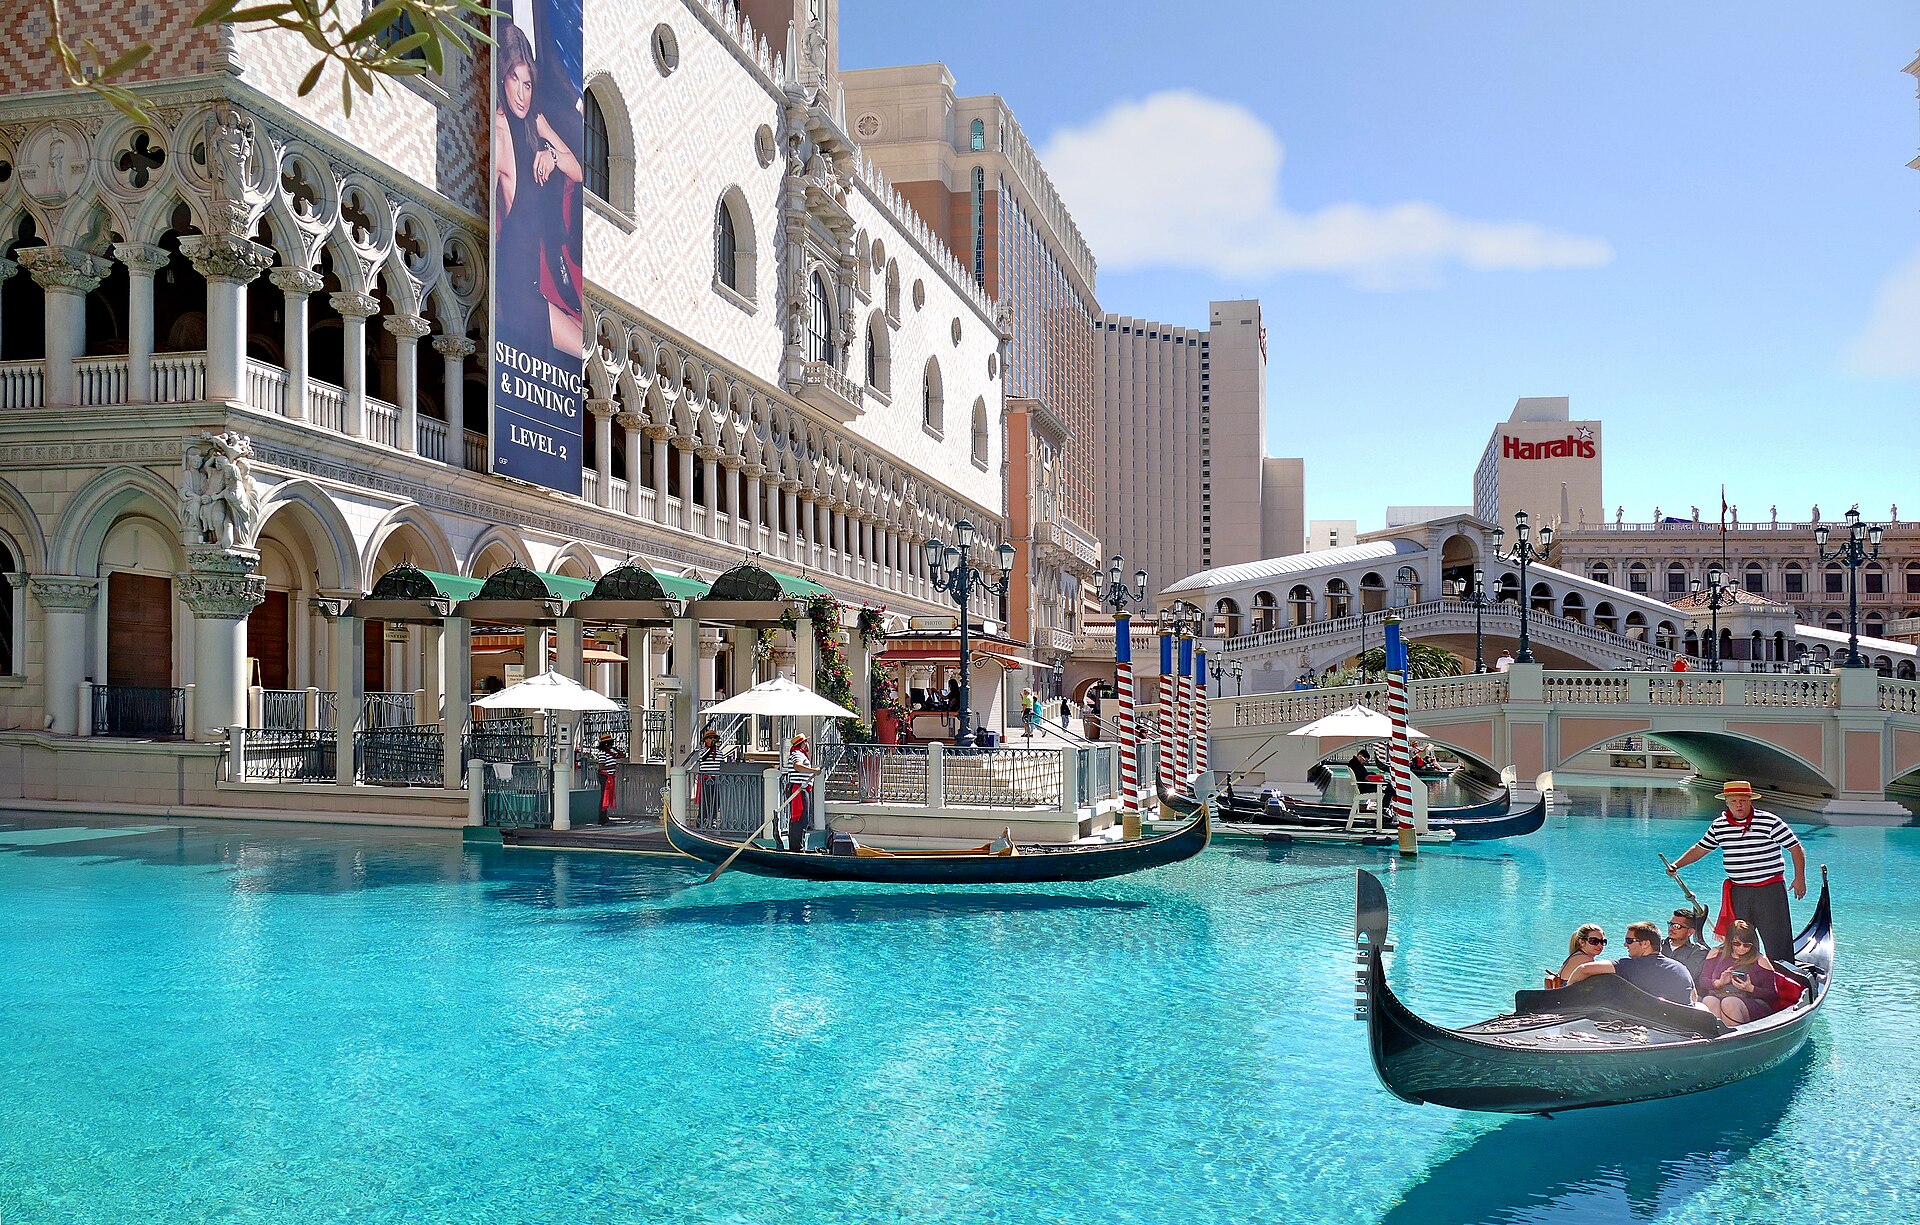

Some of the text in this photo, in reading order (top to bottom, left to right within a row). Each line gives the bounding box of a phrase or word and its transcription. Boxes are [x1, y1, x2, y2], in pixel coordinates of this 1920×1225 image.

[495, 340, 582, 394] SHOPPING
[501, 372, 577, 418] & DINING
[510, 424, 567, 461] LEVEL 2
